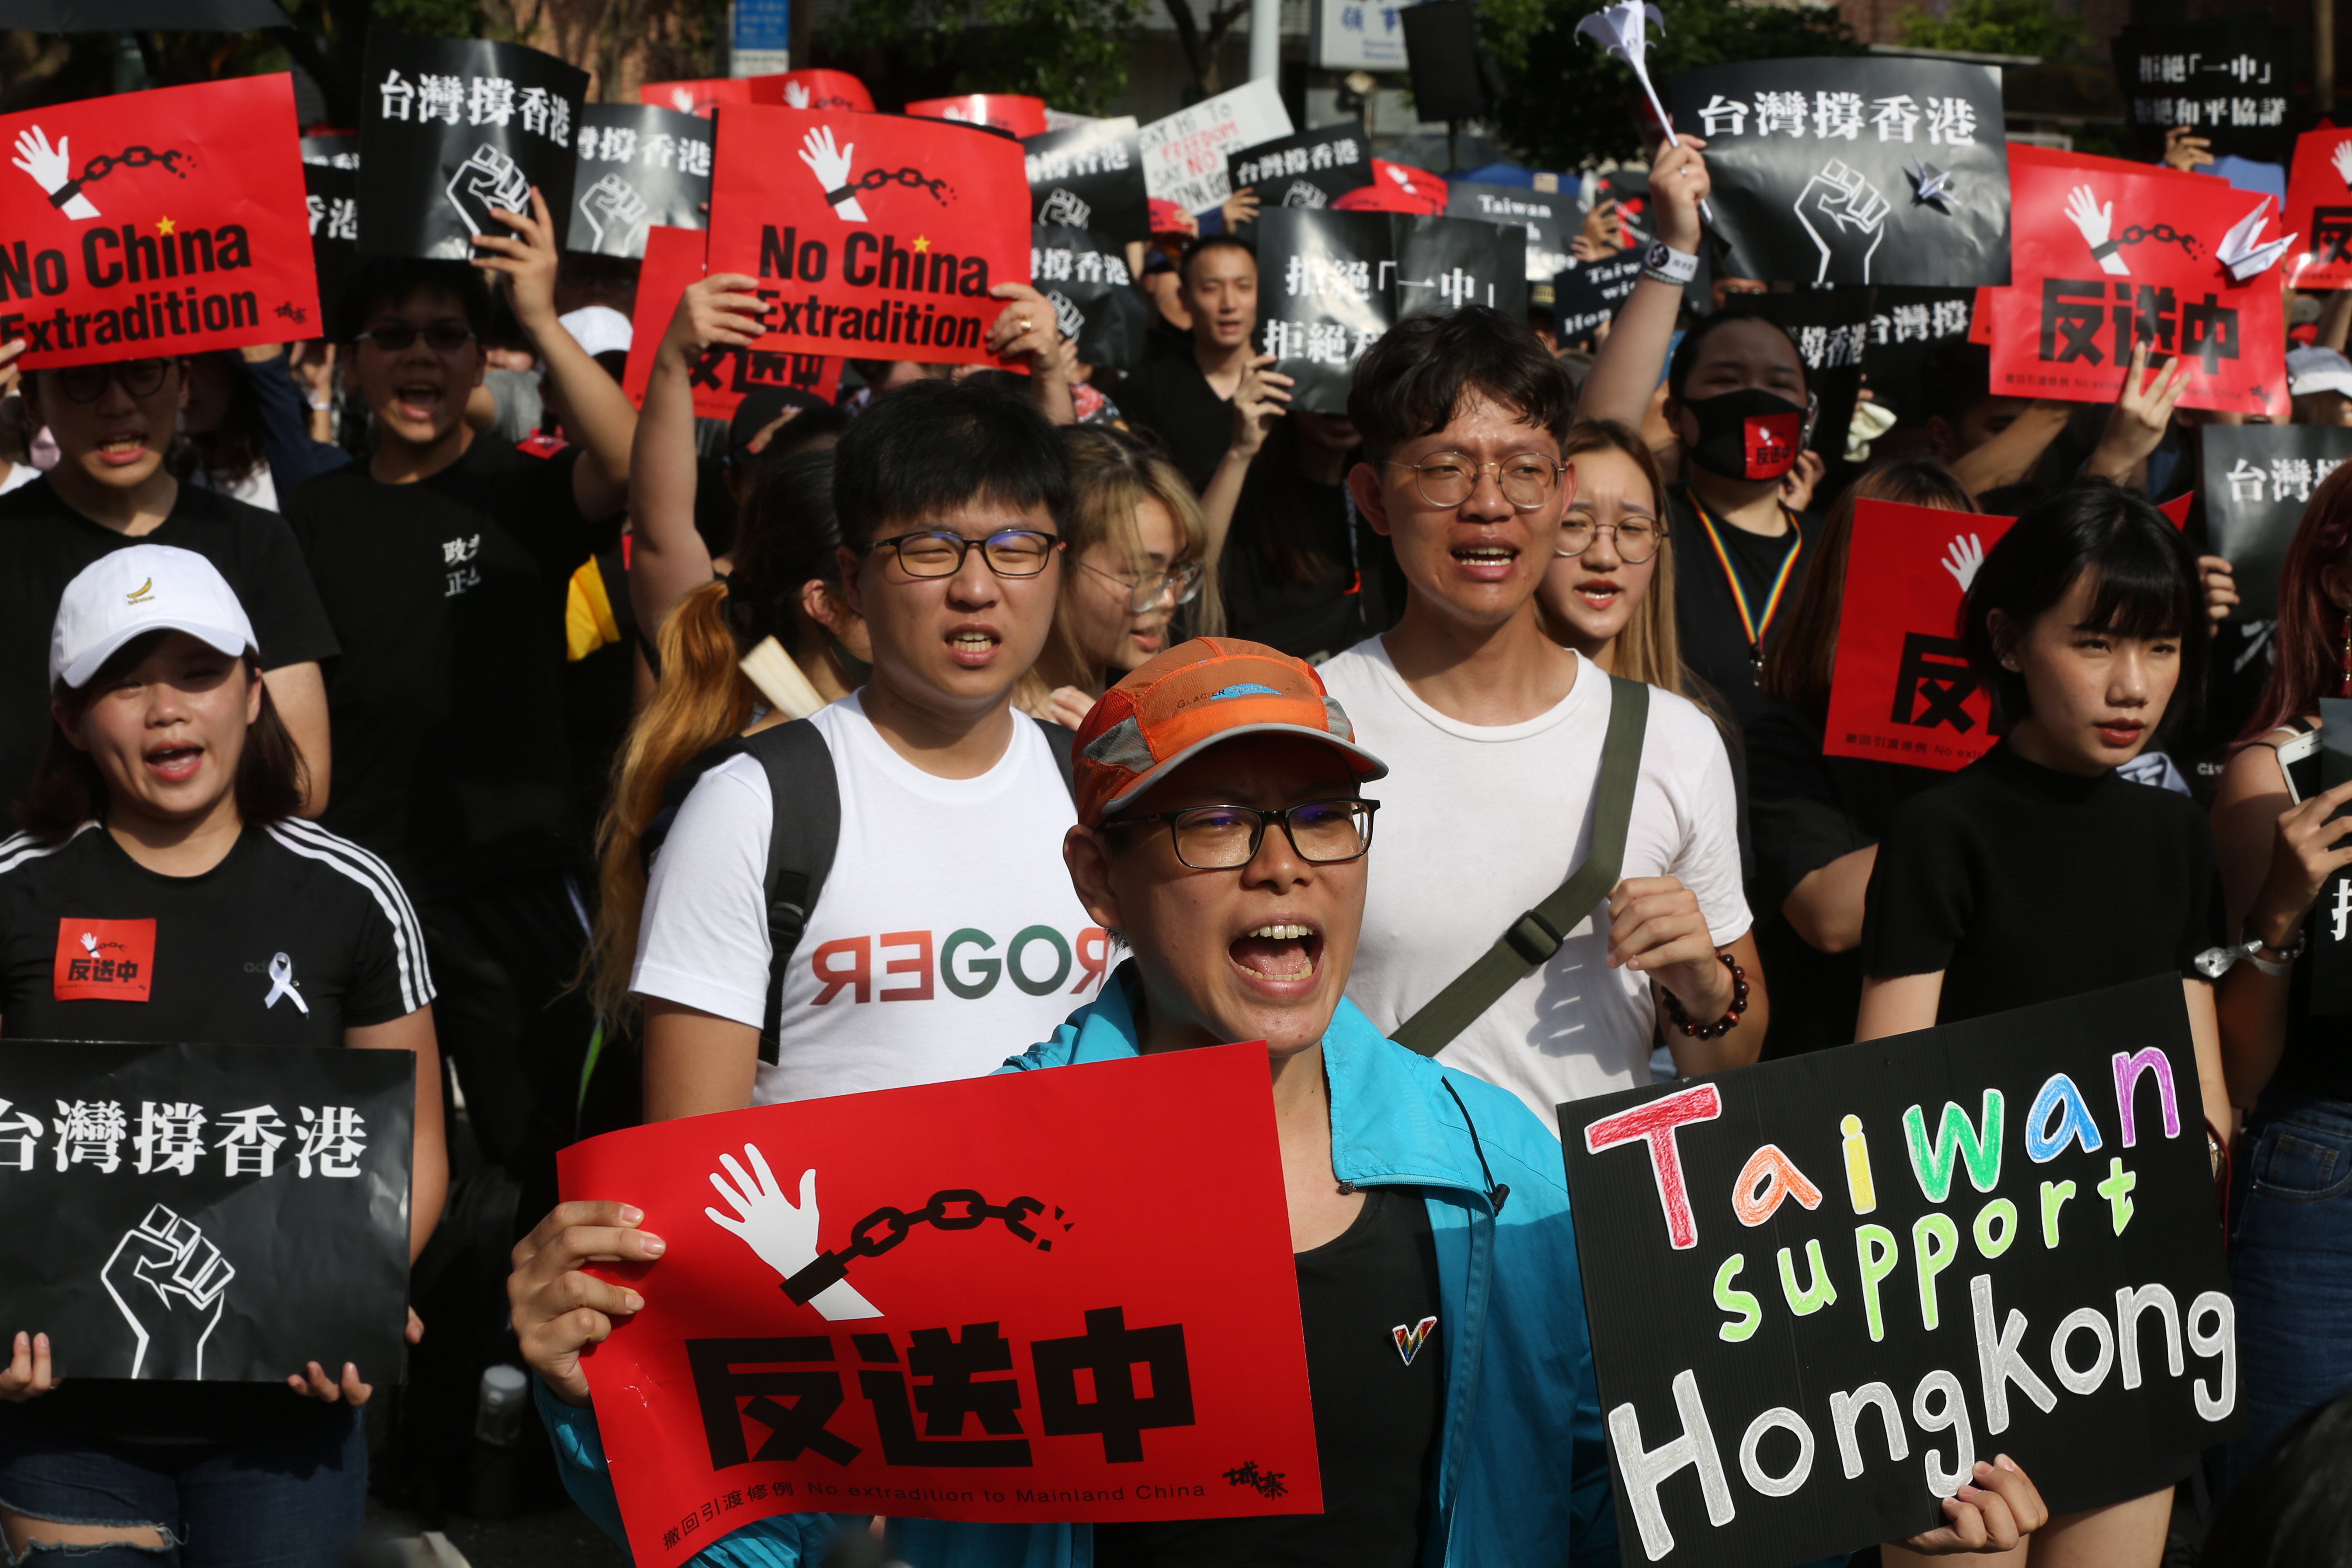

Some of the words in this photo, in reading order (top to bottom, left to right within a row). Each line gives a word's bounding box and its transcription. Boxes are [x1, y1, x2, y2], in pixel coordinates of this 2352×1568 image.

[380, 69, 570, 148] 台灣撐香港
[1698, 91, 1977, 146] 台灣撐香港
[1187, 150, 1218, 178] NO
[1237, 138, 1359, 185] 台灣撐香港
[1478, 195, 1551, 218] Taiwan
[0, 241, 68, 302] No
[82, 224, 252, 288] China
[759, 225, 828, 282] No
[843, 231, 989, 297] China
[1, 287, 259, 353] Extradition
[755, 290, 982, 348] Extradition
[2039, 277, 2240, 375] 反送中
[1934, 744, 1952, 757] No
[69, 958, 138, 983] 反送中
[0, 1099, 367, 1179] 台灣撐香港
[1584, 1046, 2180, 1250] Taiwan
[1714, 1157, 2136, 1342] support
[685, 1306, 1196, 1472] 反送中
[1222, 1461, 1288, 1501] 城寨
[663, 1481, 794, 1551] 撤回引渡修例
[807, 1482, 838, 1496] No
[849, 1486, 973, 1501] extradition
[984, 1490, 1005, 1502] to
[1016, 1487, 1125, 1503] Mainland
[1136, 1484, 1206, 1500] China
